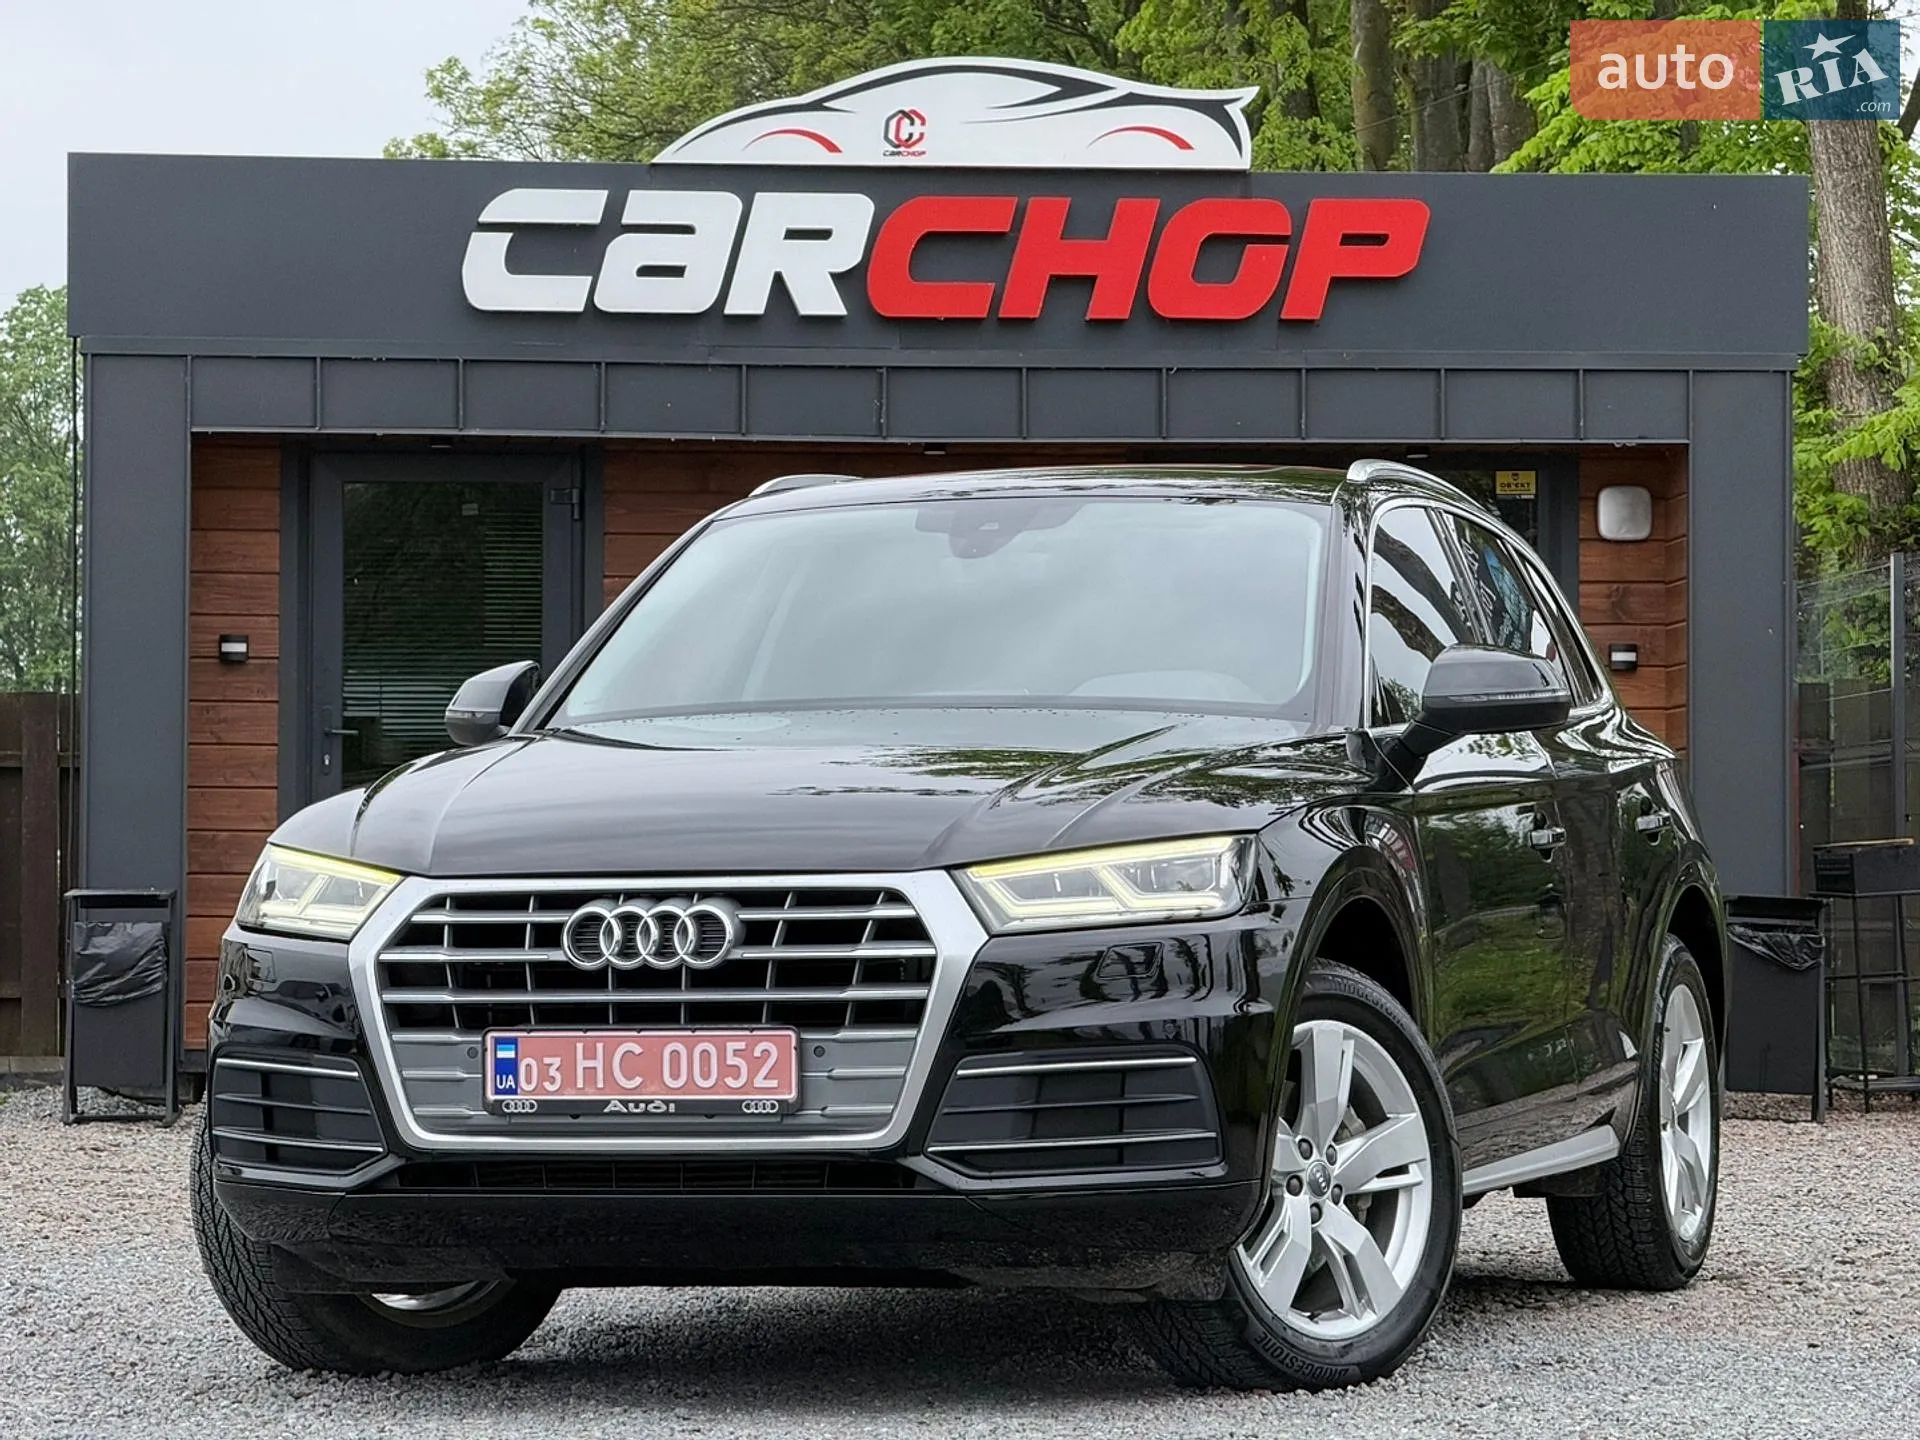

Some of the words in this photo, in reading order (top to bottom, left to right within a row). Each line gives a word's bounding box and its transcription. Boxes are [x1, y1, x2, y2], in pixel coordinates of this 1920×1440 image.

[519, 1057, 562, 1093] 03
[575, 1042, 644, 1090] HC
[662, 1041, 779, 1090] 0052
[496, 1074, 516, 1090] UA
[603, 1099, 676, 1114] Audi
